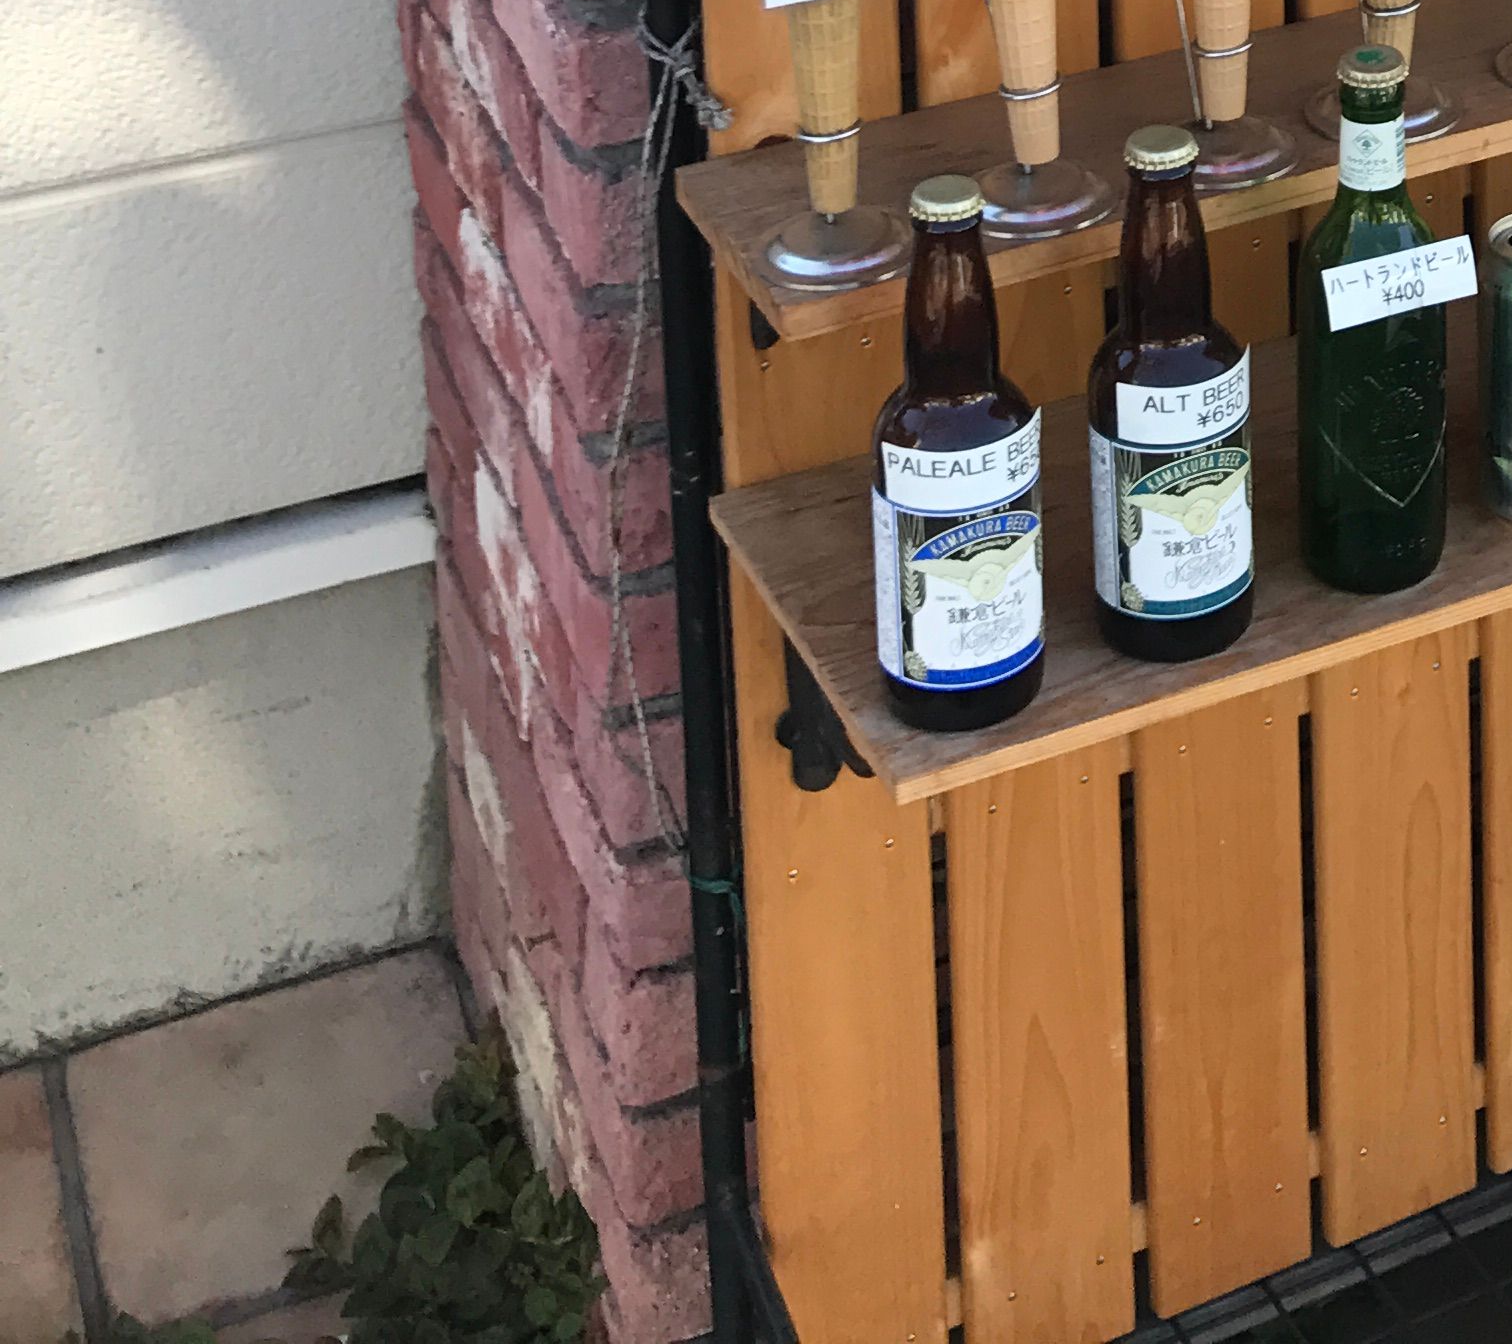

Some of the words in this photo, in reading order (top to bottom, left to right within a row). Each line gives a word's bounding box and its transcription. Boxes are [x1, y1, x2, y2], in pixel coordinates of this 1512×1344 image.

[1328, 245, 1470, 297] ハートランドビール
[1381, 278, 1426, 305] ¥400
[1142, 393, 1192, 415] ALT
[1203, 367, 1245, 407] BEER
[1196, 391, 1244, 429] ¥650
[887, 451, 997, 480] PALEALE
[1146, 455, 1215, 492] KAMAKURA
[1218, 452, 1242, 467] BEER
[929, 520, 1003, 557] KAMAKURA
[1005, 515, 1032, 531] BEER
